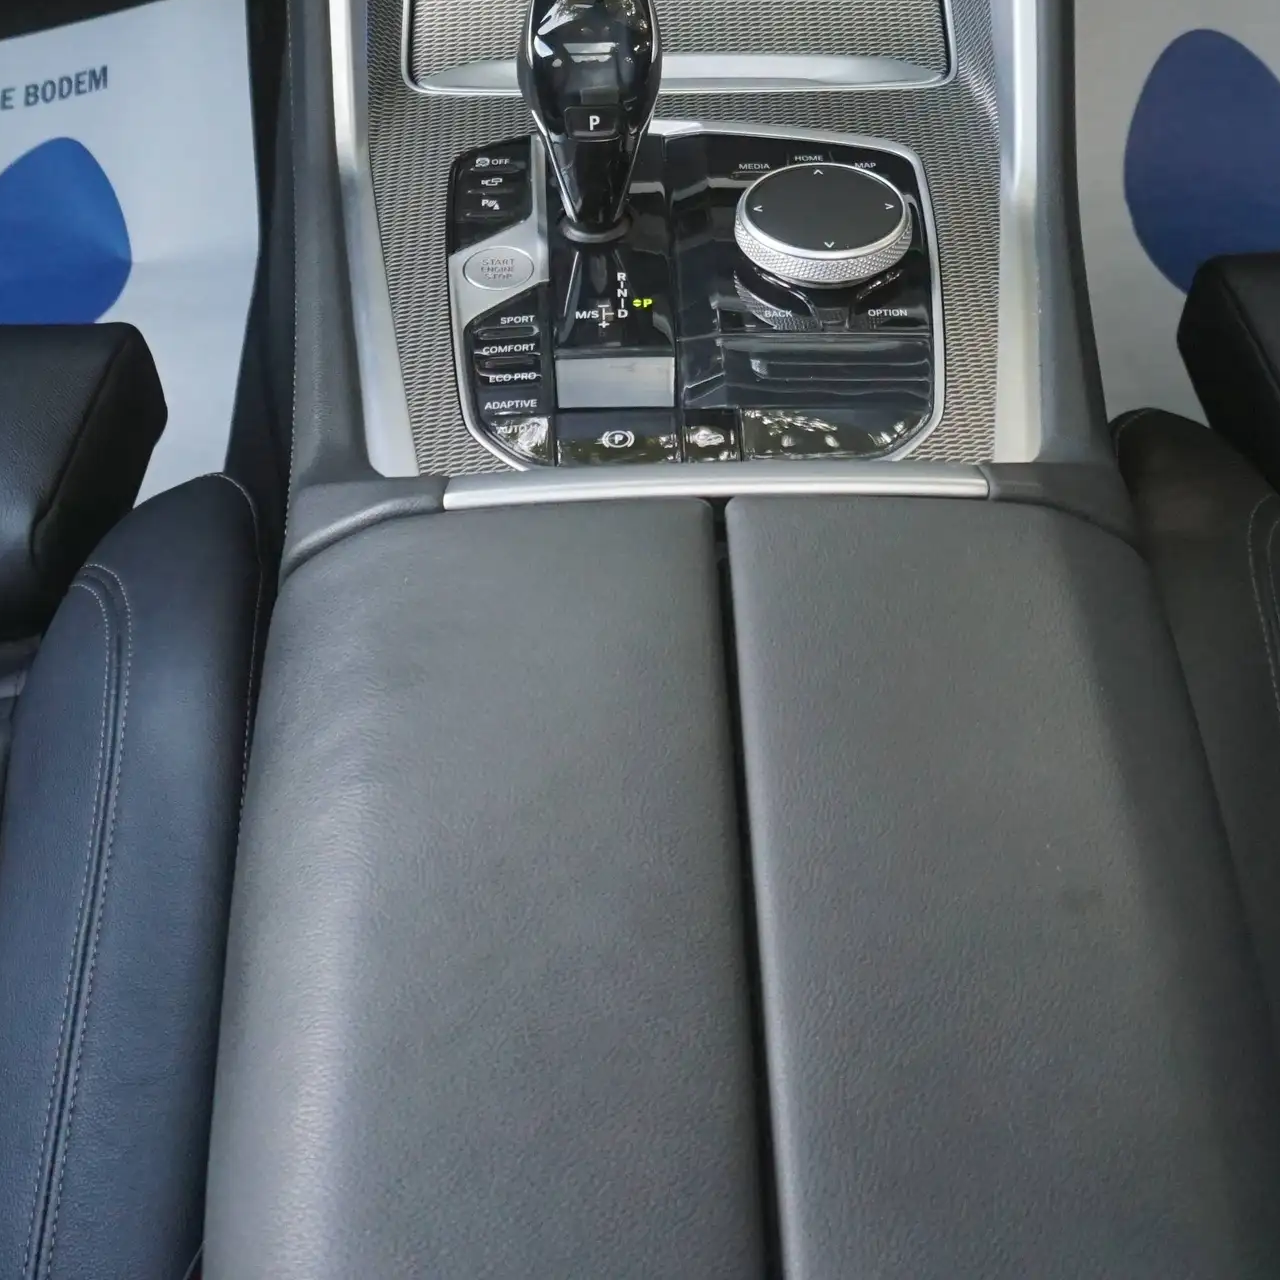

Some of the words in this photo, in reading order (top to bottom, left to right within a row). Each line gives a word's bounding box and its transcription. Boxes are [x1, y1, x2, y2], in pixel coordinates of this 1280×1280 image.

[23, 65, 109, 108] BODEM
[589, 116, 600, 131] P
[484, 272, 512, 280] STOP
[617, 272, 626, 281] R
[617, 289, 627, 298] N
[643, 298, 653, 308] P
[575, 310, 600, 320] M/S
[617, 308, 628, 319] D
[764, 309, 793, 318] BACK
[867, 308, 908, 317] OPTION
[500, 314, 536, 325] SPORT
[482, 343, 536, 355] COMFORT
[488, 374, 513, 384] ECO
[513, 371, 537, 381] PRO
[484, 398, 538, 410] ADAPTIVE
